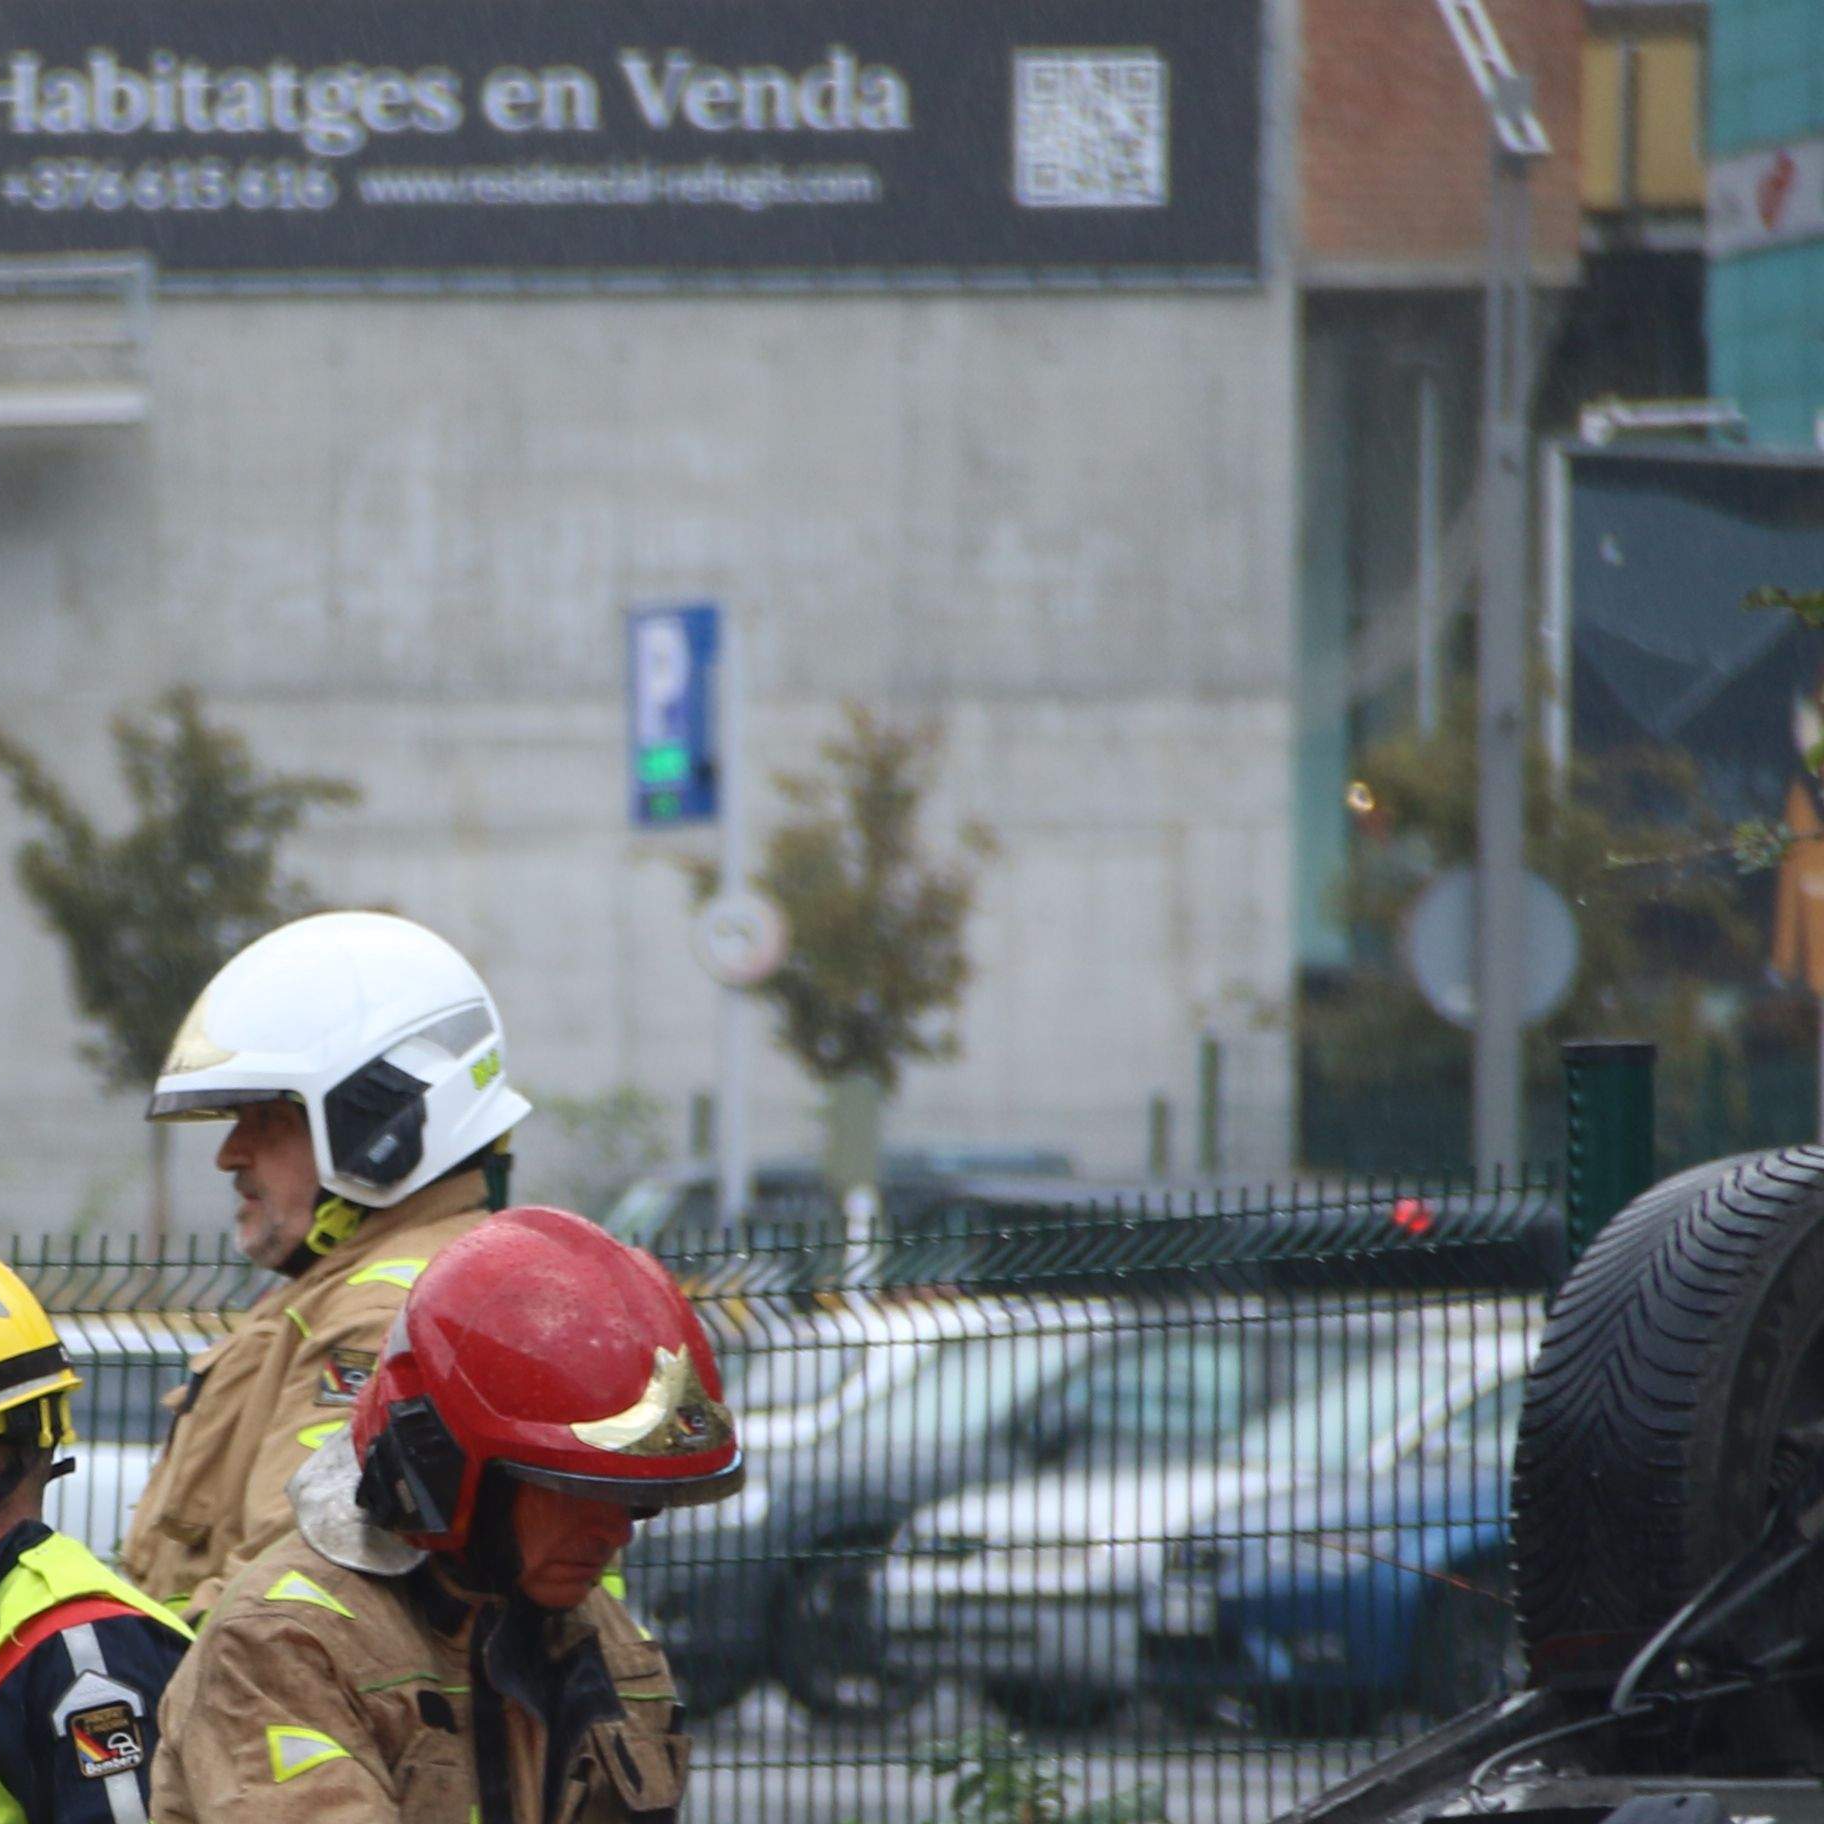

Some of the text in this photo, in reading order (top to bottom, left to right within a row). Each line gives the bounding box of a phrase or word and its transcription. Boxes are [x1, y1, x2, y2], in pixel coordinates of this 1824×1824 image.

[483, 64, 599, 132] en
[618, 43, 911, 131] Venda
[0, 156, 128, 210] +376
[234, 158, 339, 210] 616
